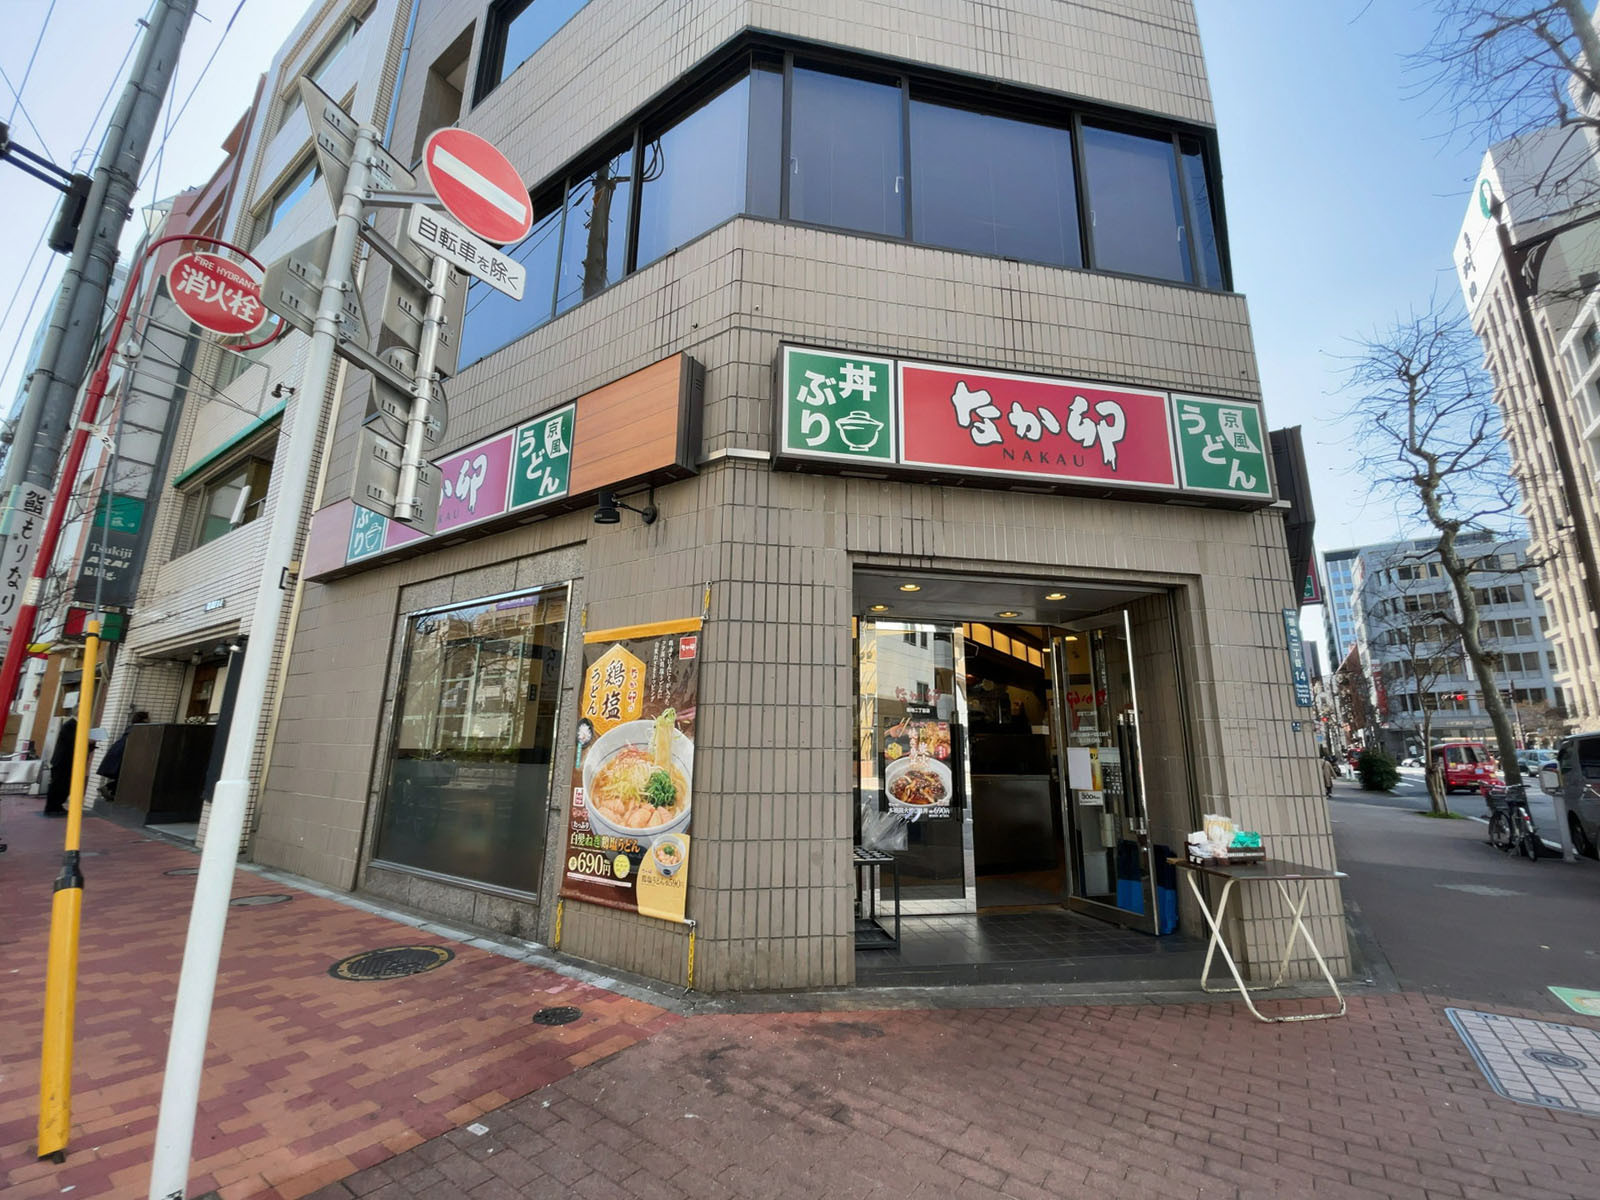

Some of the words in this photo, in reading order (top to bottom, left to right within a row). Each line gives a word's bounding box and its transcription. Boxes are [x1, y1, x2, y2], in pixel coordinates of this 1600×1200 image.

[193, 256, 214, 271] FIRE
[216, 266, 258, 291] HYDRANT
[418, 216, 519, 291] 自転車を除く
[176, 264, 260, 324] 消火栓
[950, 380, 1127, 472] なか卯
[1180, 404, 1257, 490] うどん
[1221, 408, 1250, 451] 京風
[519, 430, 560, 497] うどん
[1003, 446, 1086, 469] NAKAU
[91, 542, 133, 560] Tsukiji
[587, 668, 601, 716] うどん
[602, 660, 626, 720] 鶏塩
[1295, 671, 1306, 681] 14
[578, 851, 611, 877] 690円
